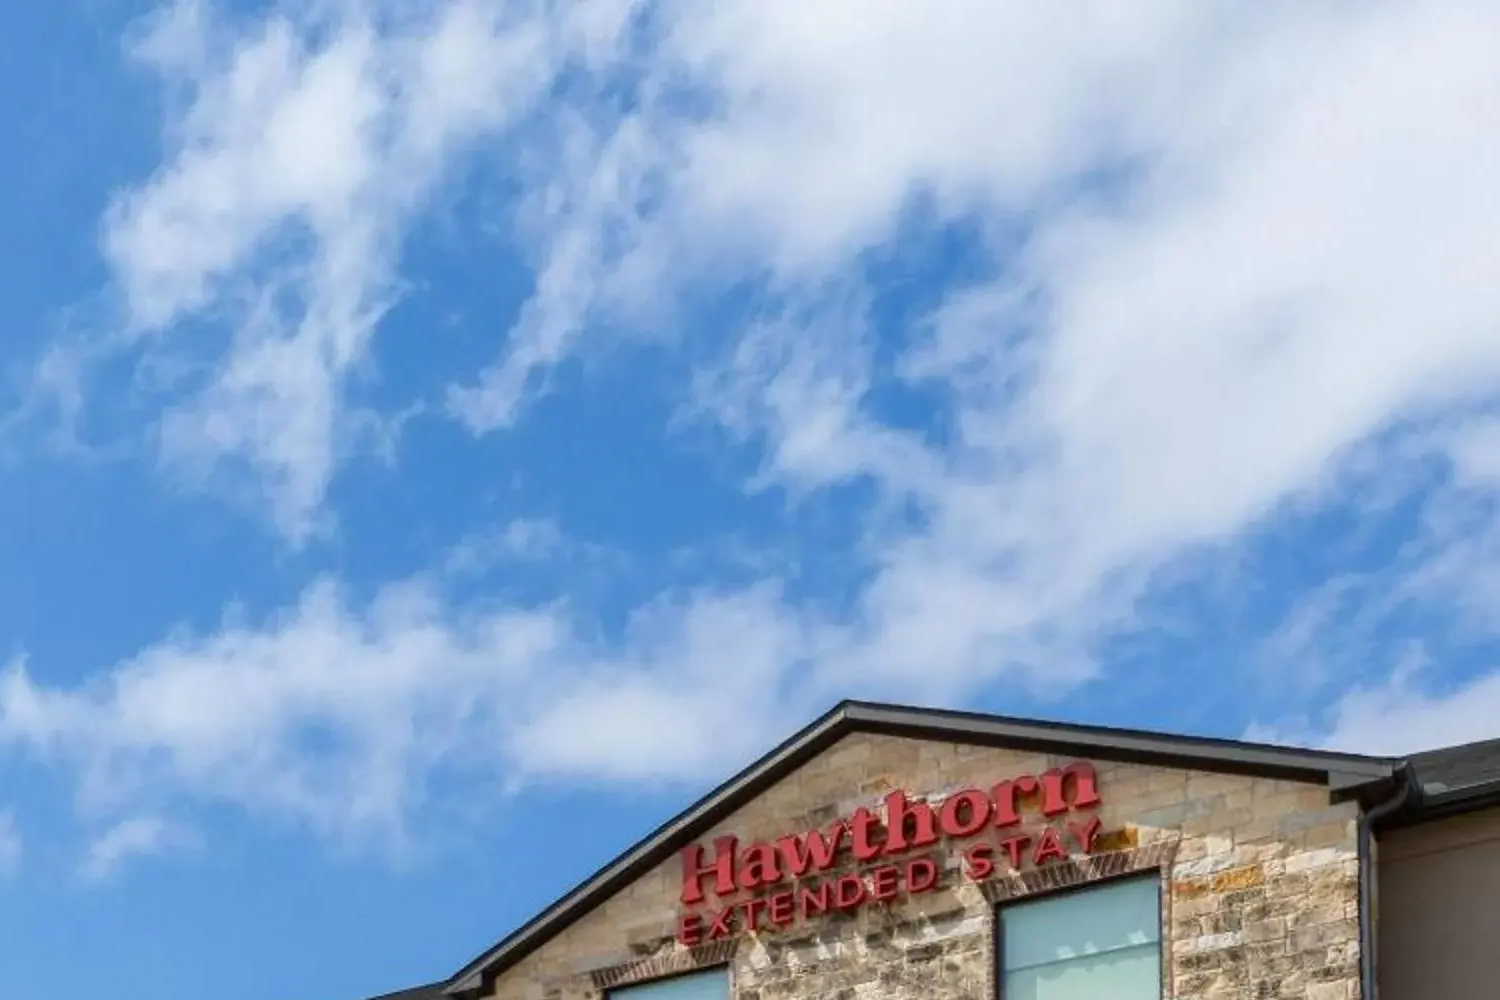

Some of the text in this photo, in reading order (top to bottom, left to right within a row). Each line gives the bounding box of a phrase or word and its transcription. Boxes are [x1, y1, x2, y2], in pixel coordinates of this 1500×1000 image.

[679, 818, 1101, 945] EXTENDED STAY
[680, 762, 1100, 902] Hawthorn
